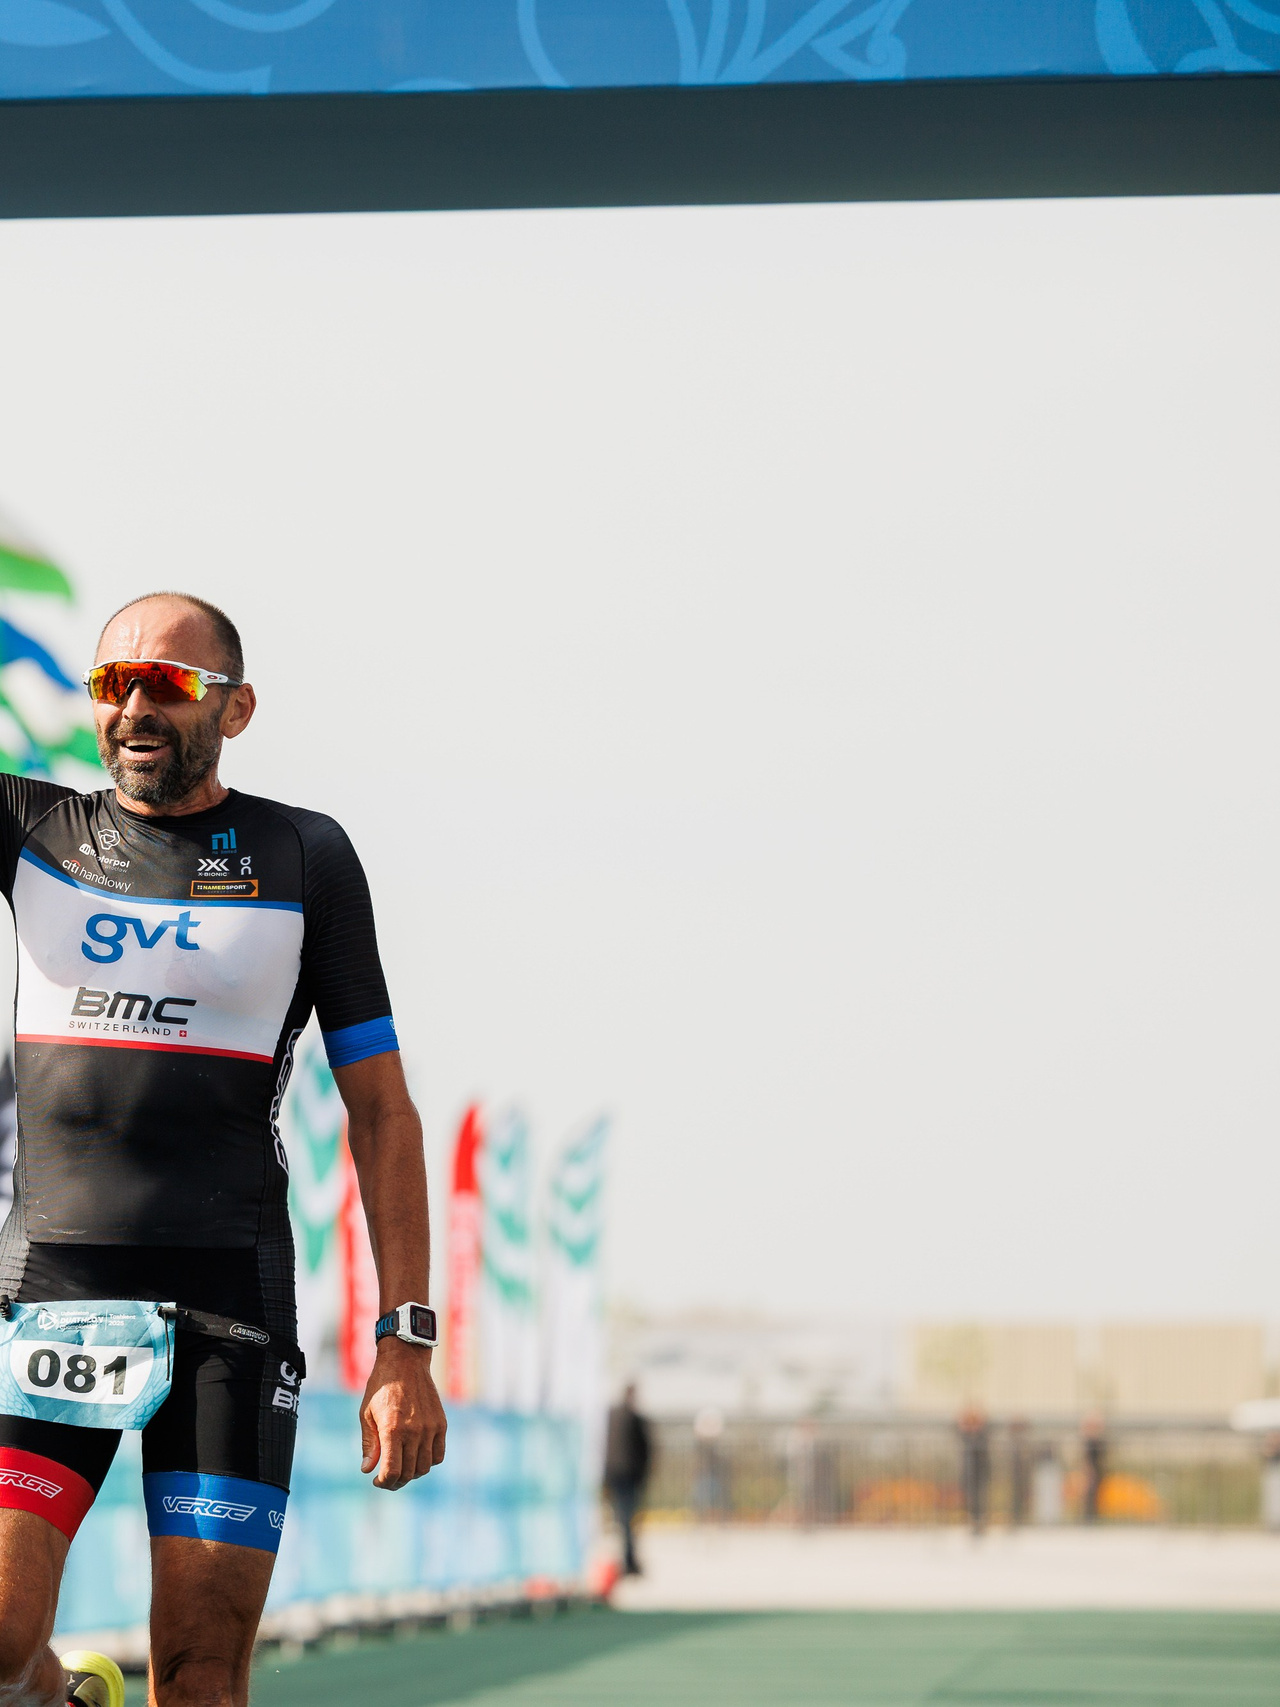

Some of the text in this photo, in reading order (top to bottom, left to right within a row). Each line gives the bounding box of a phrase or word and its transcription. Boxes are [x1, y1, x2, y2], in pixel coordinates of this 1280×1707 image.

[62, 859, 132, 893] citi handlowy
[81, 910, 202, 964] gvt
[71, 987, 197, 1026] BMC
[68, 1020, 172, 1037] SWITZERLAND
[27, 1348, 128, 1396] 081
[162, 1496, 258, 1522] VERGE
